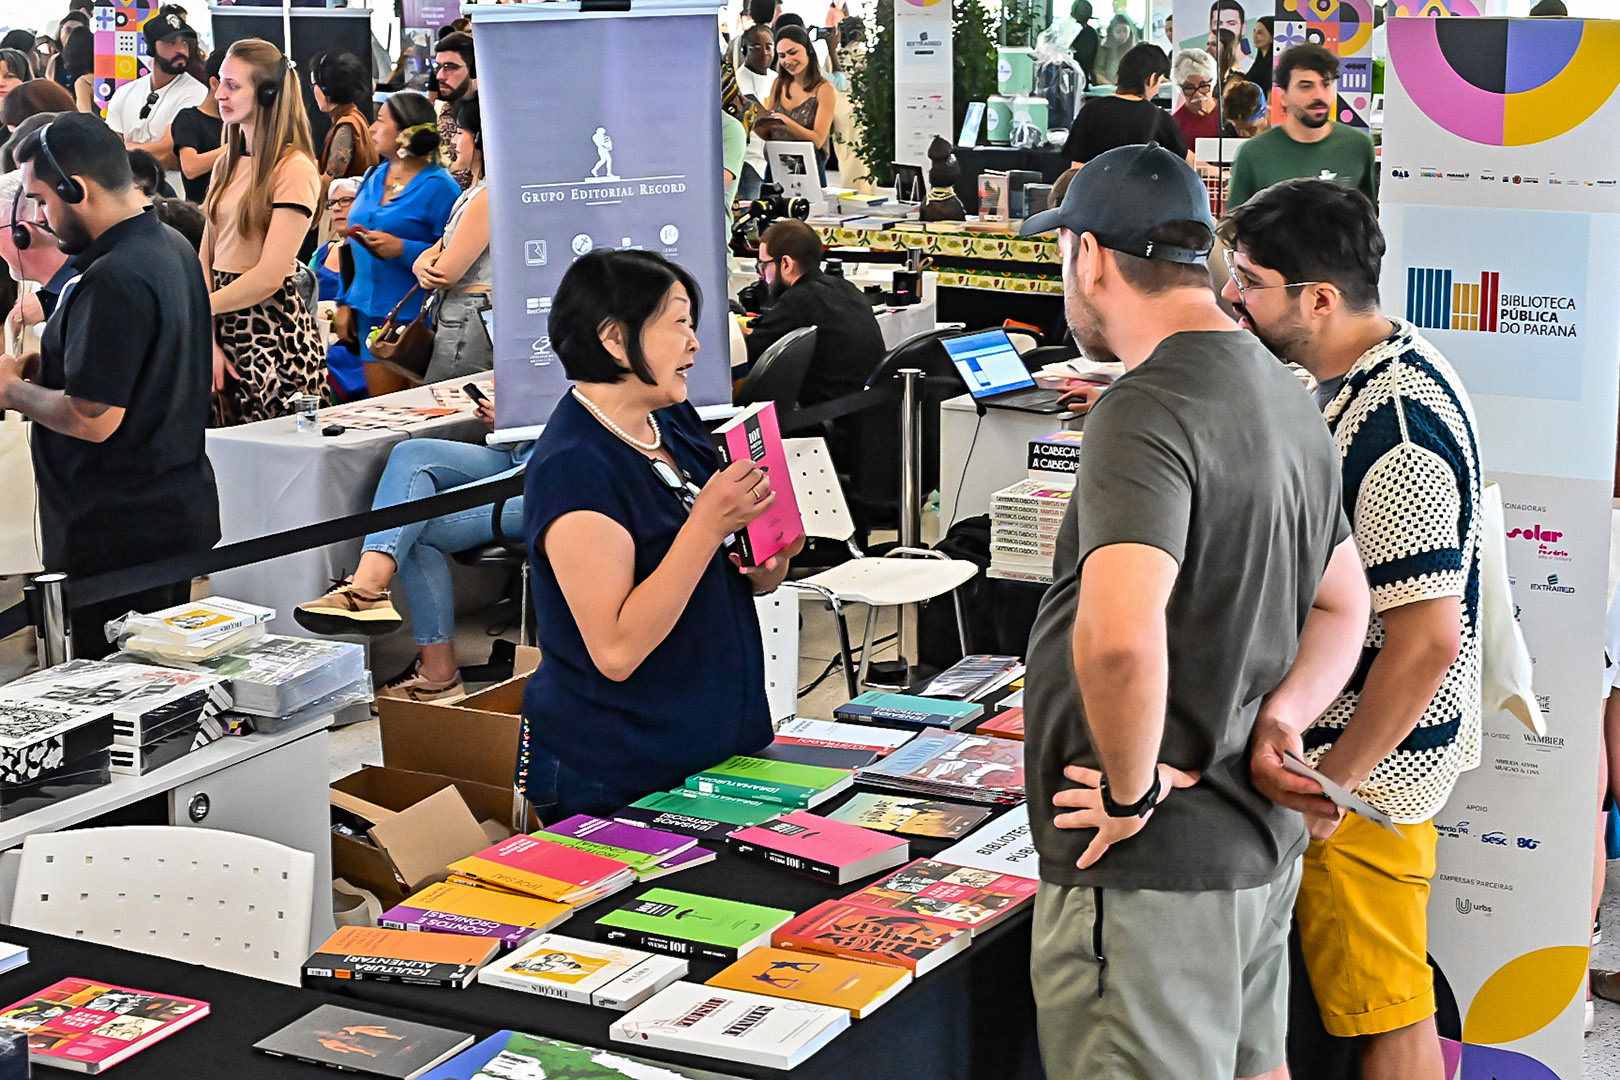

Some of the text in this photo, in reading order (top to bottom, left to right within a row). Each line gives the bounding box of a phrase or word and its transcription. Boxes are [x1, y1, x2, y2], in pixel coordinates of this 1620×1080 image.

[521, 182, 686, 204] GRUPO EDITORIAL RECORD
[1500, 293, 1576, 310] BIBLIOTECA
[1500, 307, 1559, 323] PÚBLICA
[1500, 321, 1577, 338] DO PARANÁ
[1033, 444, 1040, 454] A
[1041, 445, 1076, 458] CABEÇA
[1032, 458, 1039, 468] A
[1040, 458, 1075, 471] CABEÇA
[1506, 524, 1563, 543] solar
[1530, 583, 1575, 594] EXTRAMED
[1523, 733, 1565, 746] WAMBIER
[1465, 804, 1488, 812] APOIO
[786, 856, 801, 869] 101
[1440, 874, 1513, 892] EMPRESAS PARCEIRAS
[1473, 902, 1492, 913] urbs
[669, 940, 688, 953] 101
[531, 984, 569, 999] FICÇÕES
